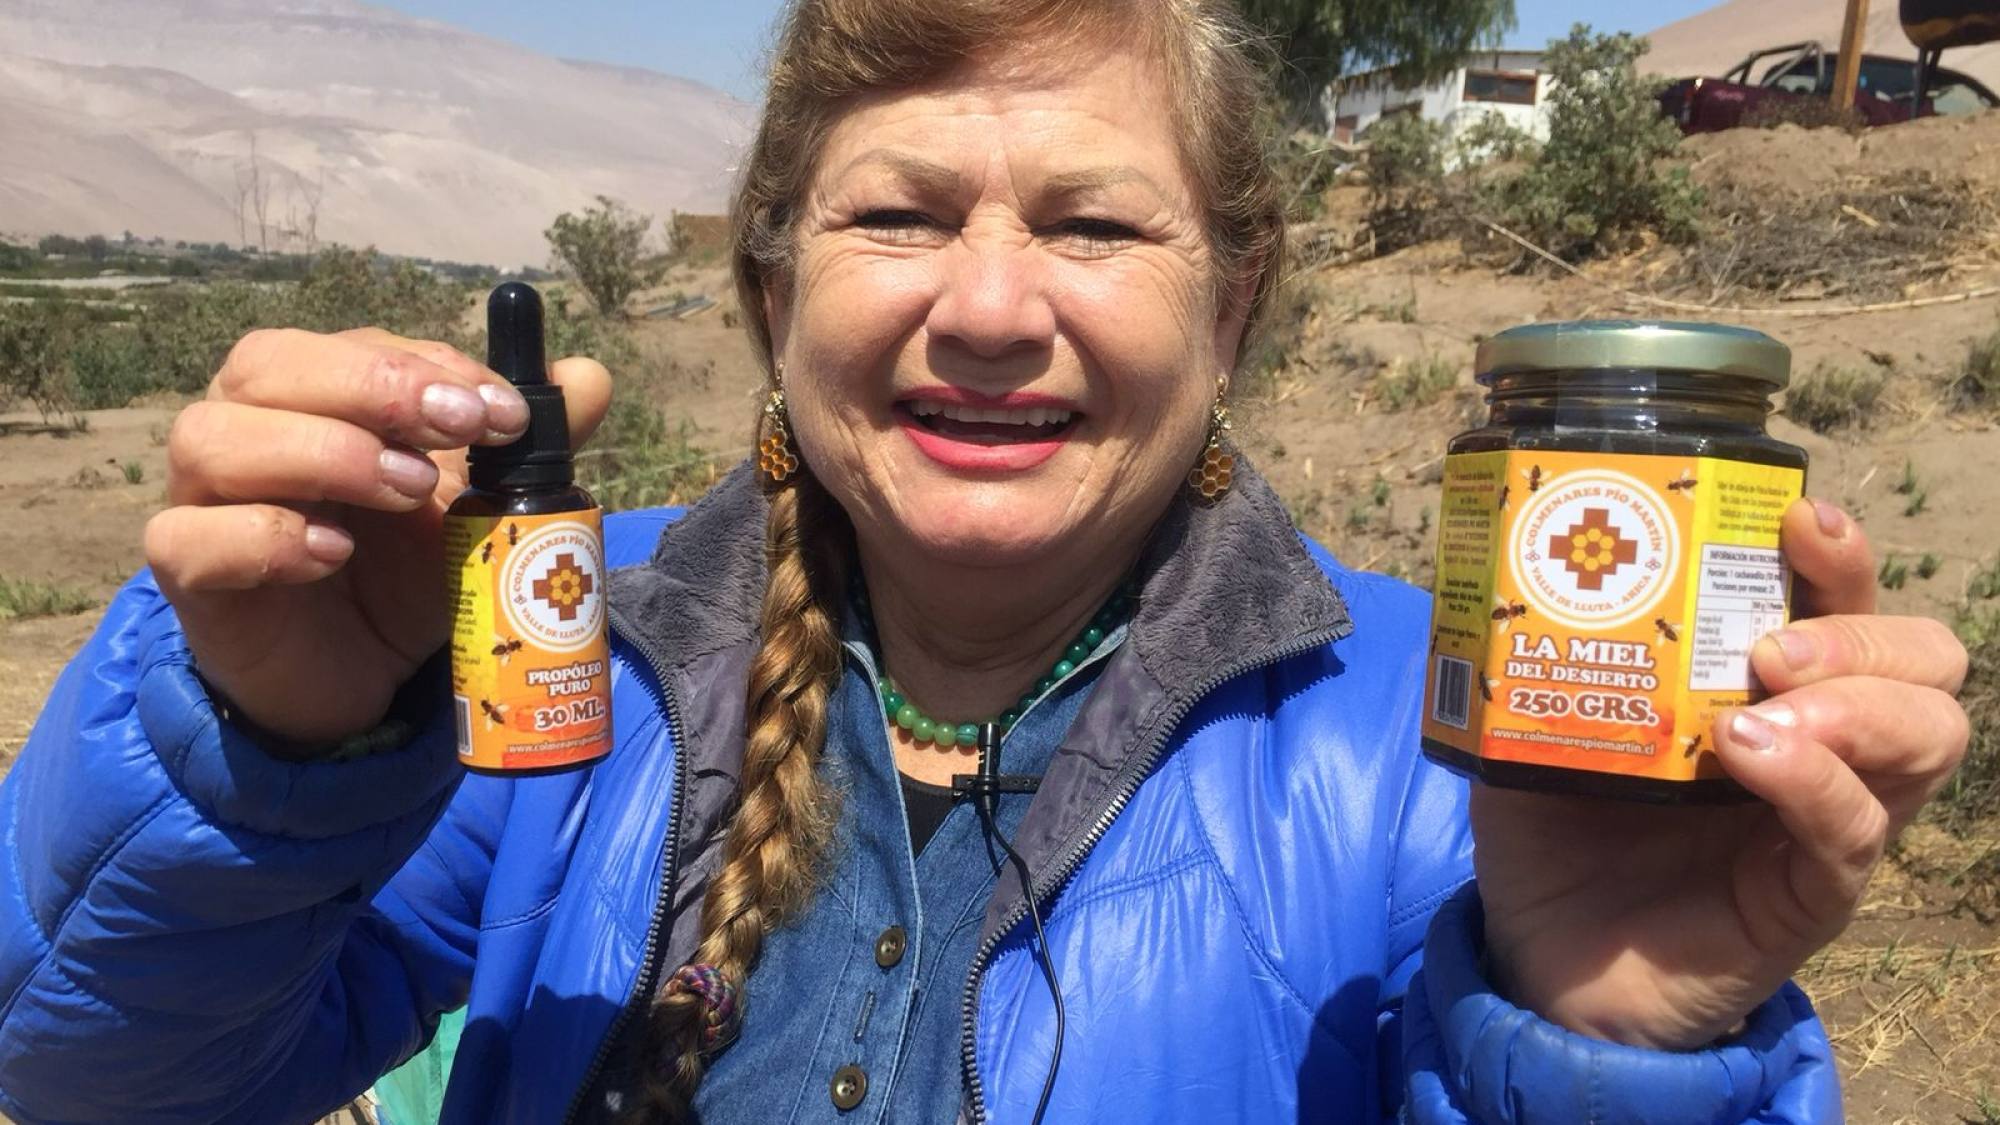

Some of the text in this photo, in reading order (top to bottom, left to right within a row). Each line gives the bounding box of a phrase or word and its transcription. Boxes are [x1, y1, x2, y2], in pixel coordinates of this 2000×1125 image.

[1526, 487, 1664, 552] COLMENARES PÍO MARTÍN
[513, 535, 567, 592] COLMENARES
[1532, 566, 1555, 600] VALLE
[1558, 594, 1571, 608] DE
[1574, 602, 1615, 612] LLUTA
[1621, 574, 1651, 605] ARICA
[521, 607, 543, 633] VALLE
[545, 627, 558, 637] DE
[560, 627, 586, 639] LLUTA
[1513, 634, 1654, 669] LA MIEL
[526, 661, 602, 686] PROPÓLEO
[548, 678, 591, 697] PURO
[1505, 660, 1658, 690] DEL DESIERTO
[534, 696, 606, 731] 30 ML.
[1510, 688, 1660, 728] 250 GRS.
[1491, 728, 1655, 757] www.colmenarespiomartin.cl
